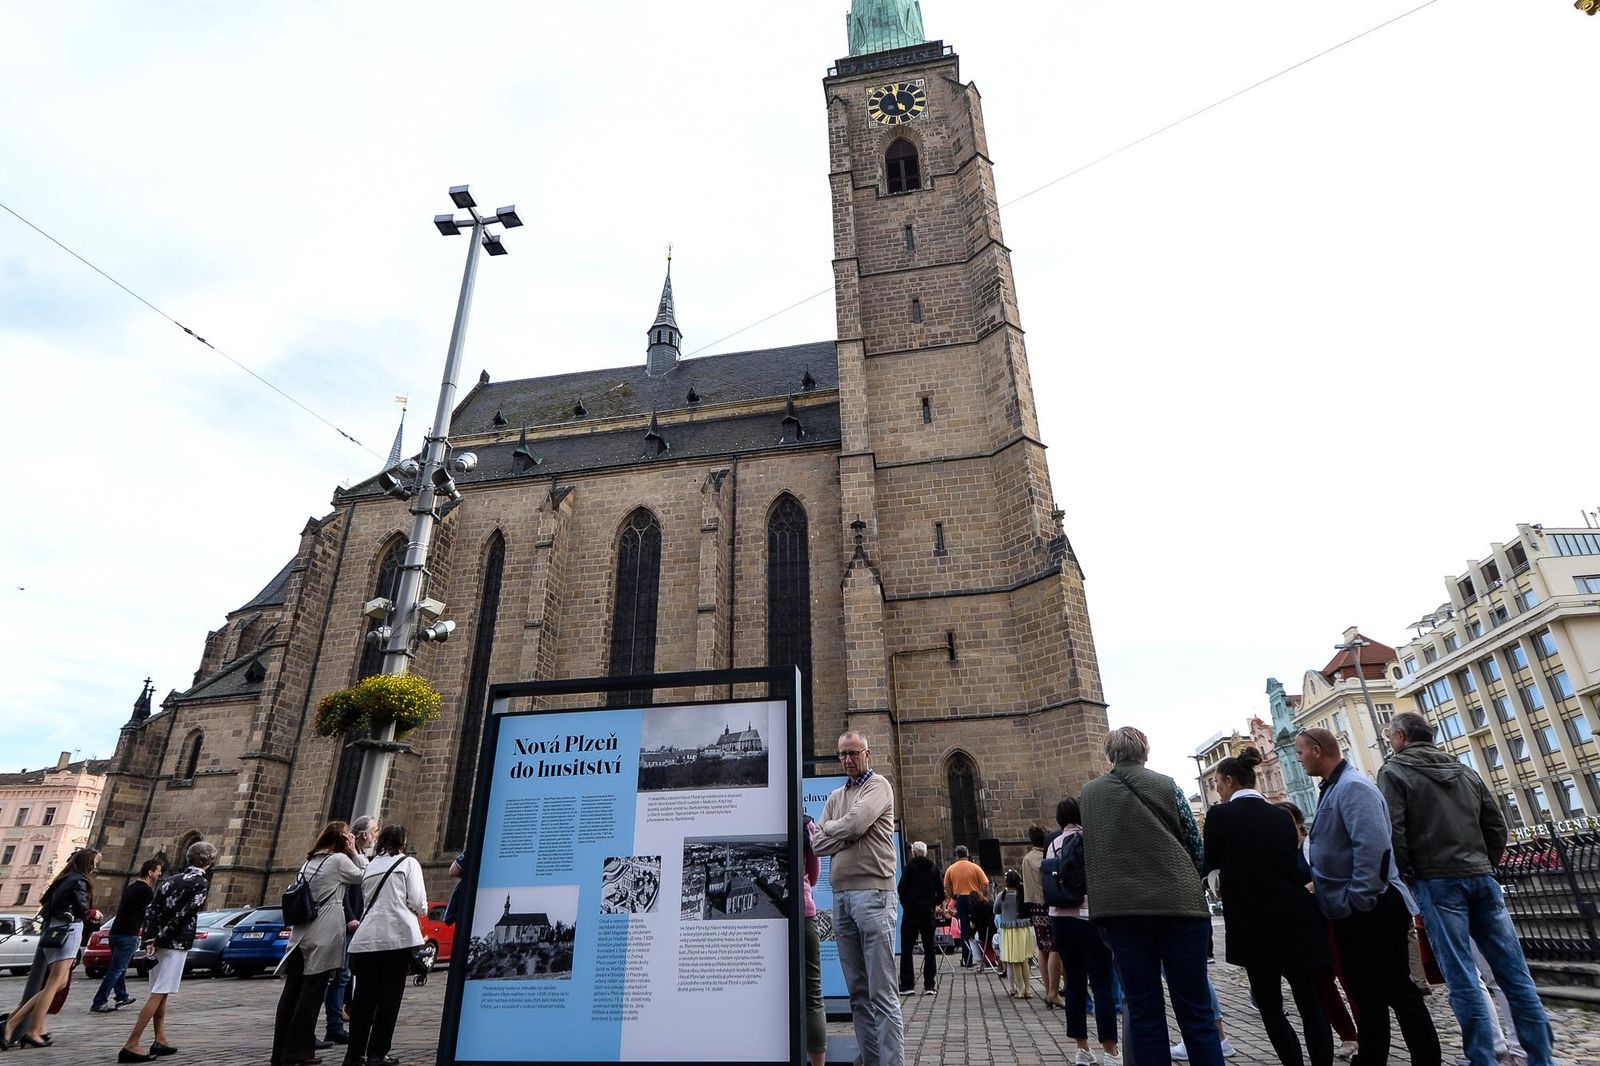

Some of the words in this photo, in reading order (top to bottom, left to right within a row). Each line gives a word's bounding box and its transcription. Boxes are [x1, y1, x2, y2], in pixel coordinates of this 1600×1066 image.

[513, 735, 560, 755] Nová
[565, 732, 618, 752] Plzeň
[510, 761, 534, 779] do
[537, 755, 621, 777] husitství
[804, 794, 827, 802] clava
[1512, 823, 1550, 839] HOTEL
